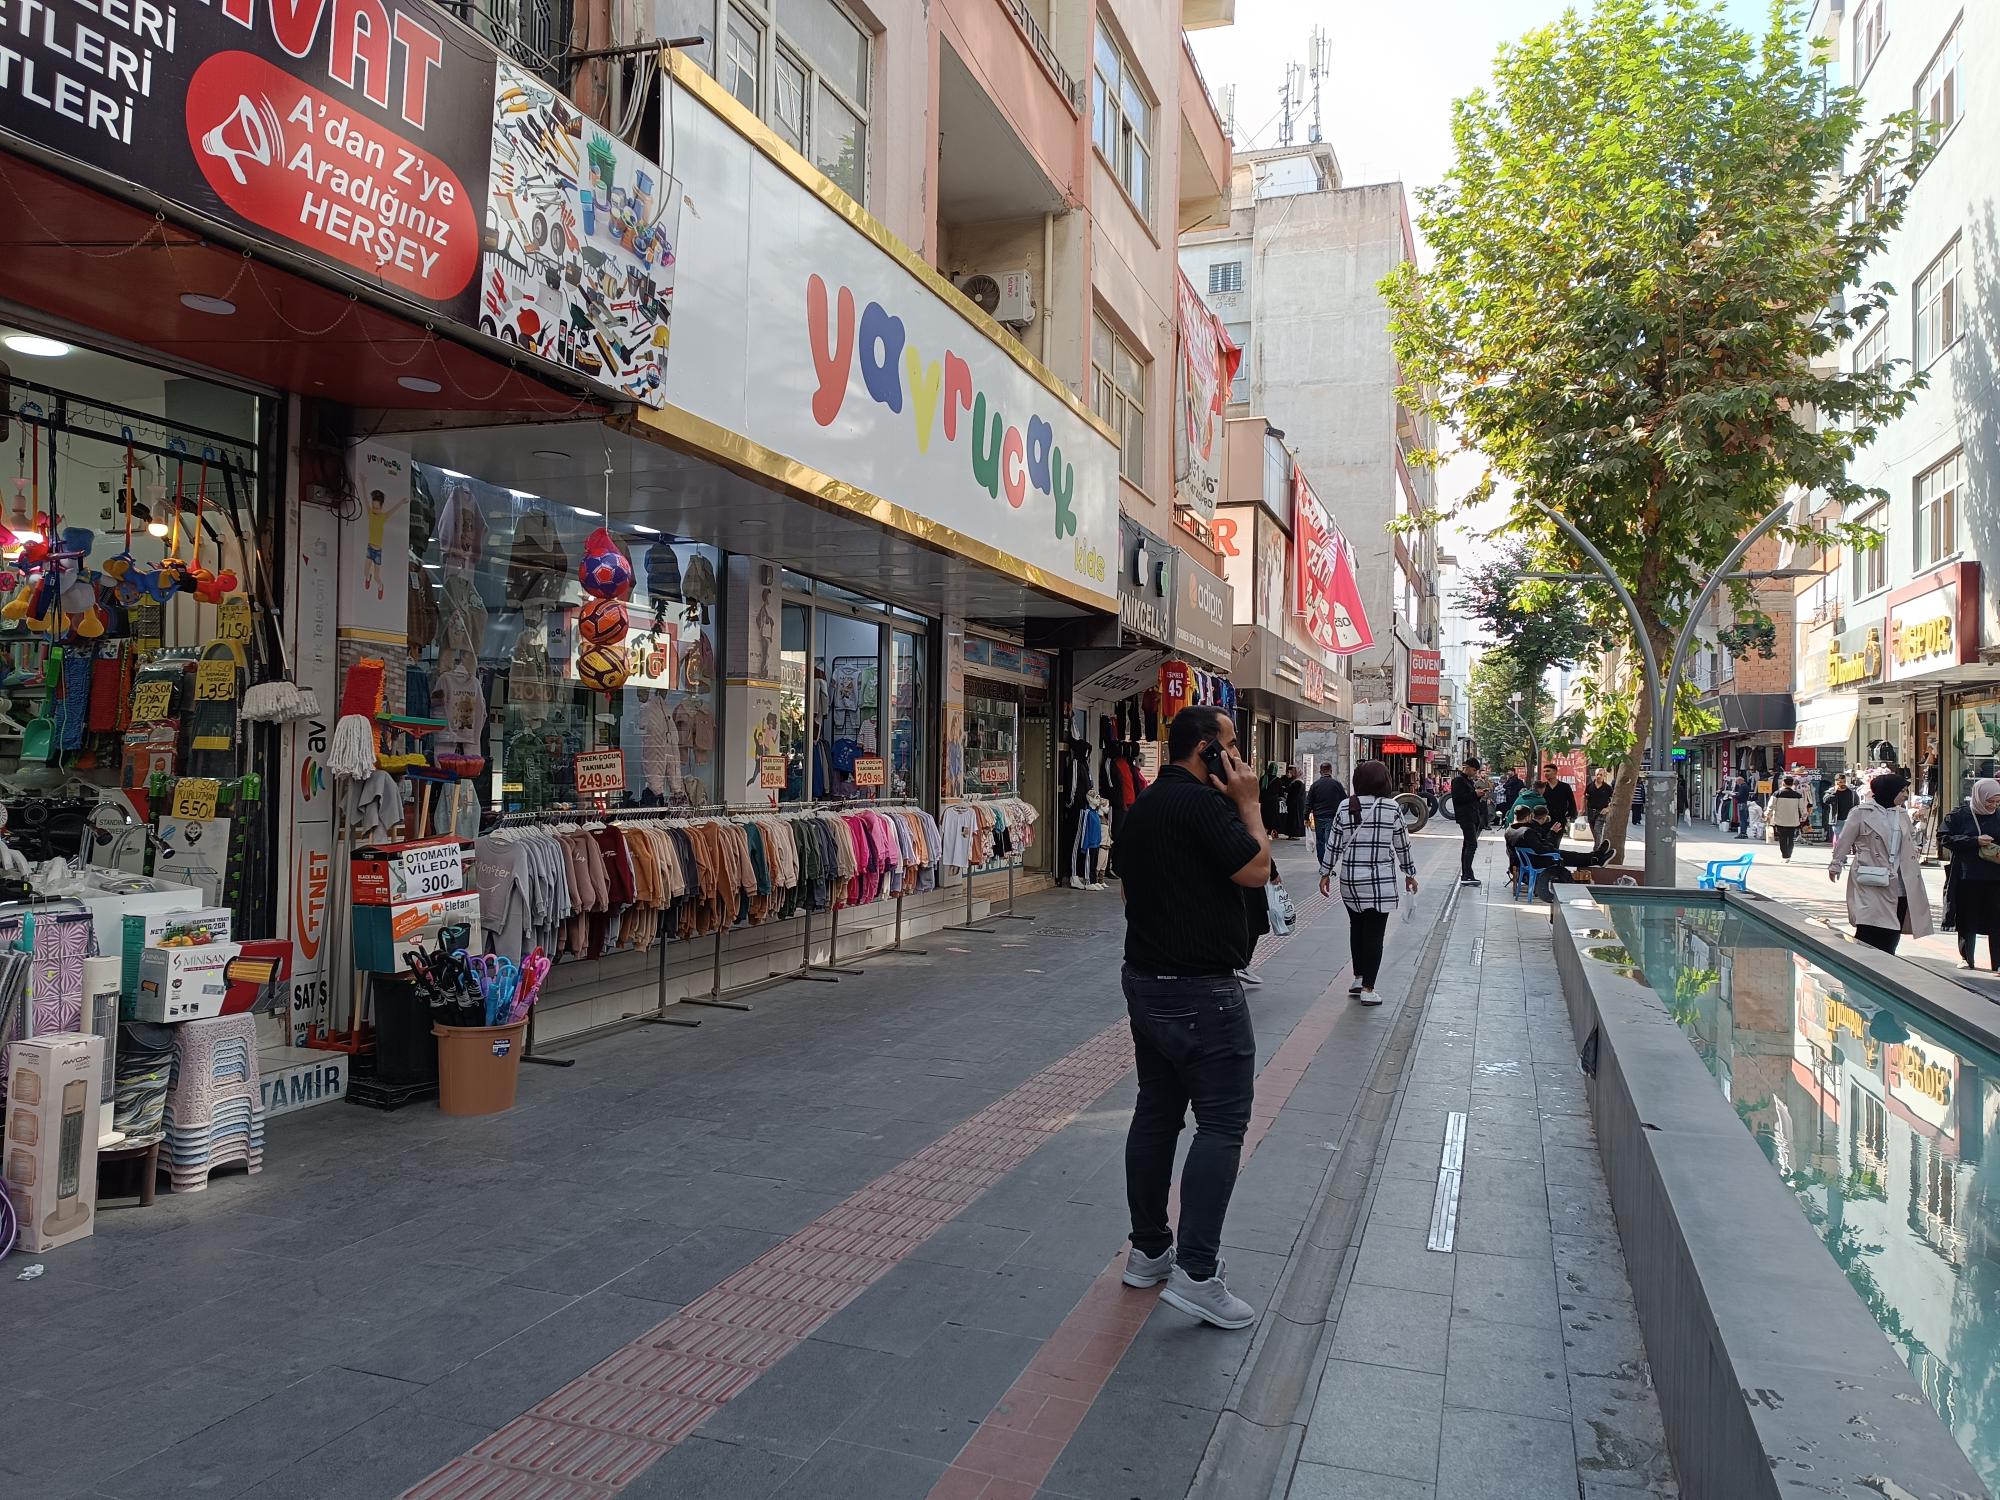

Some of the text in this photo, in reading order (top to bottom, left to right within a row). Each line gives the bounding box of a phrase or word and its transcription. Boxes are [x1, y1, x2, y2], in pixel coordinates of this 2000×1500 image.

[287, 142, 451, 246] Aradığınız
[299, 190, 441, 278] HERŞEY
[806, 273, 1077, 540] yavrucak
[1073, 537, 1106, 583] kids
[1198, 583, 1224, 622] adipro
[1412, 656, 1440, 671] GÜVEN
[1168, 679, 1183, 697] 45
[582, 763, 616, 771] TAKIMLARI
[599, 753, 621, 761] ÇOCUK
[406, 845, 459, 863] OTOMATİK
[407, 858, 459, 875] VİLEDA
[308, 850, 329, 932] TTNET
[294, 980, 328, 1013] SATŞ
[259, 1064, 340, 1111] TAMİR
